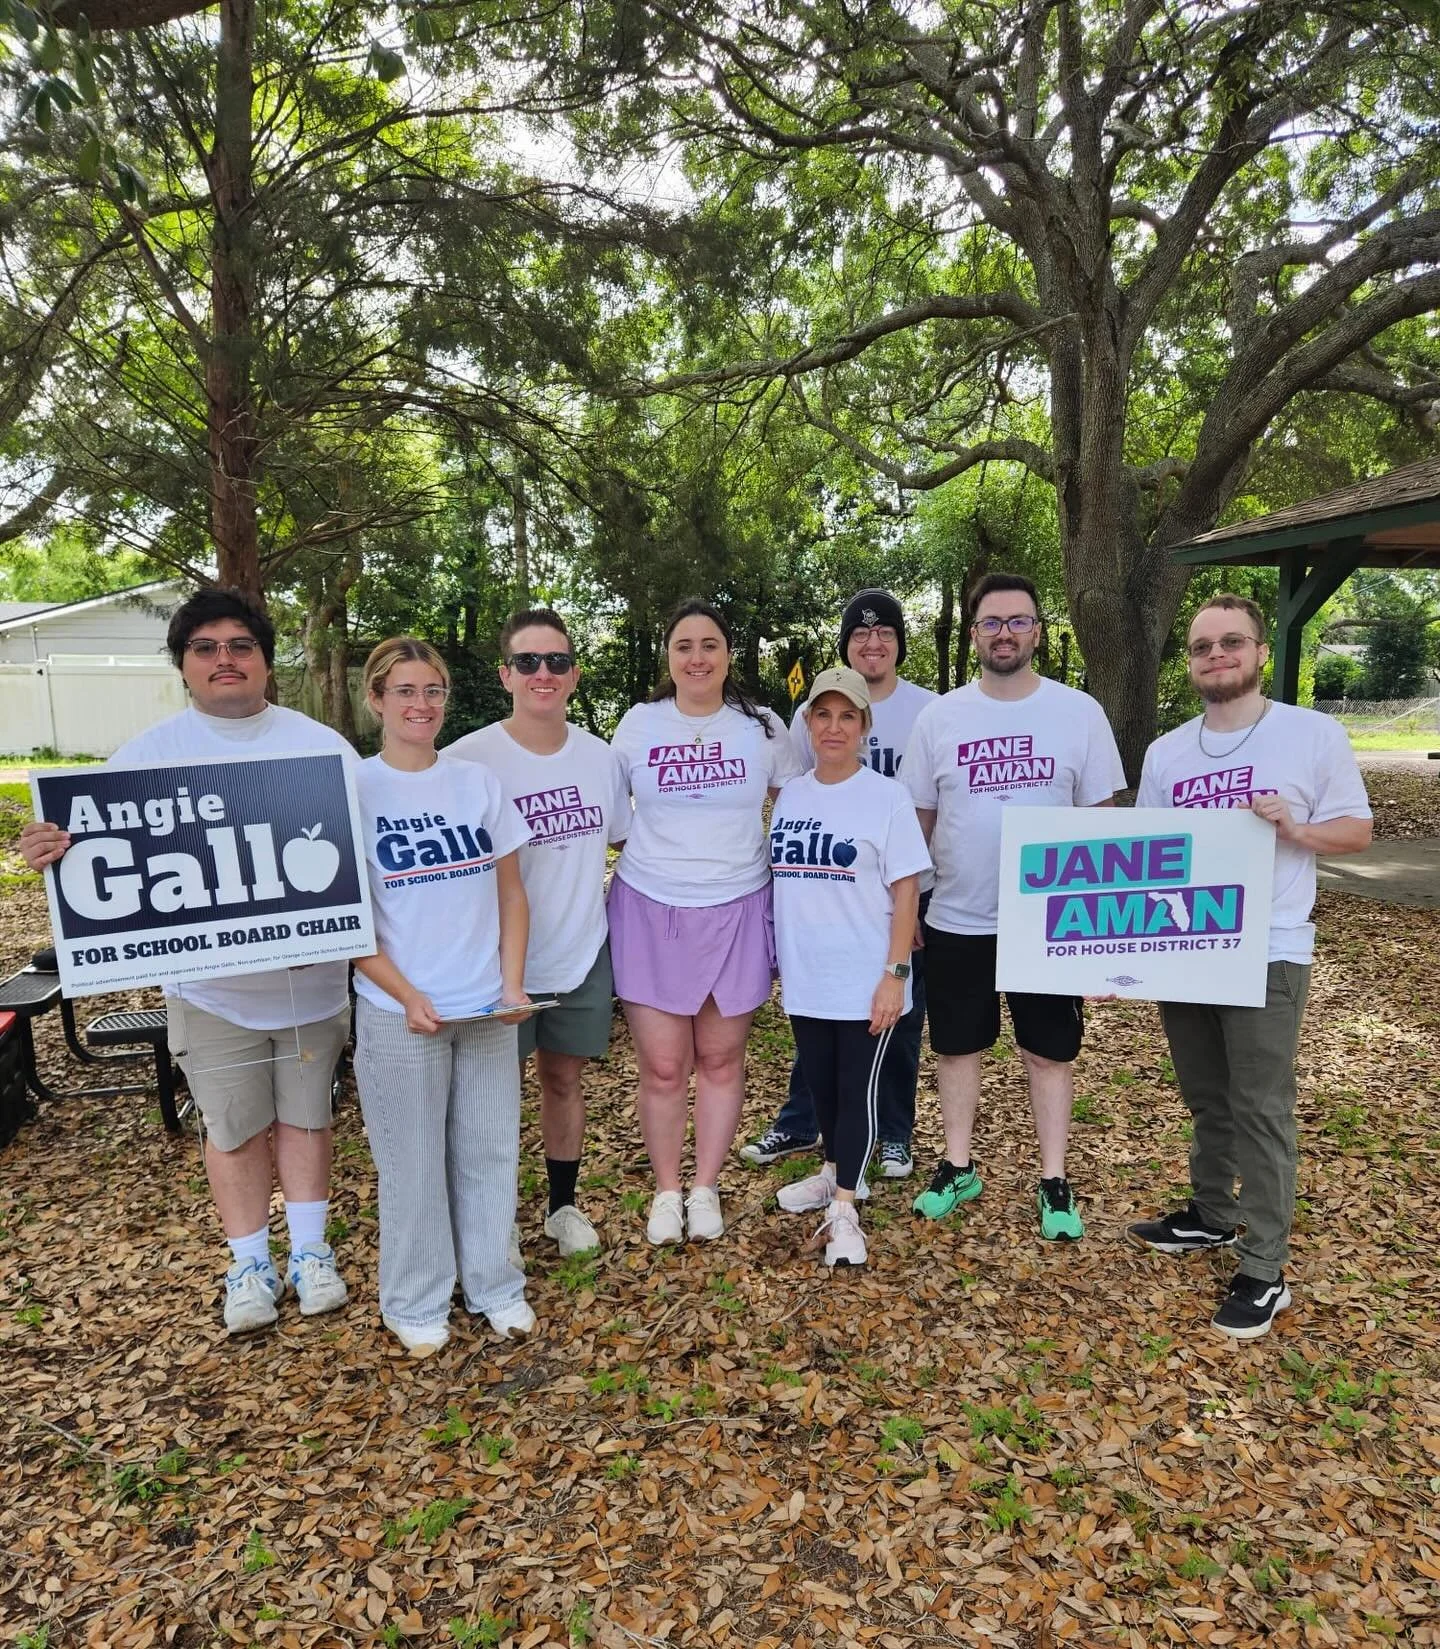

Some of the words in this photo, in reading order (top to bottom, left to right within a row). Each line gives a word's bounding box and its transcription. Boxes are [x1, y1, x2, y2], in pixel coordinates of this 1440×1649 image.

[650, 743, 720, 764] JANE
[960, 737, 1030, 763] JANE
[661, 760, 744, 785] AMAN
[972, 758, 1052, 785] AMAN
[703, 781, 737, 789] DISTRICT
[1174, 767, 1250, 803] JANE
[67, 787, 225, 836] Angie
[520, 788, 579, 816] JANE
[376, 813, 446, 833] Angie
[532, 807, 601, 838] AMAN
[544, 835, 567, 845] HOUSE
[567, 830, 596, 839] DISTRICT
[1024, 837, 1185, 888] JANE
[384, 880, 405, 889] FOR
[408, 872, 447, 885] SCHOOL
[450, 867, 481, 879] BOARD
[803, 871, 829, 880] BOARD
[830, 873, 855, 883] CHAIR
[1051, 888, 1237, 939] AMAN
[72, 947, 118, 967] FOR
[123, 934, 212, 958] SCHOOL
[216, 924, 291, 948] BOARD
[296, 915, 361, 936] CHAIR
[1047, 946, 1077, 957] FOR
[1082, 942, 1136, 955] HOUSE
[1141, 939, 1218, 952] DISTRICT
[1223, 938, 1241, 949] 37
